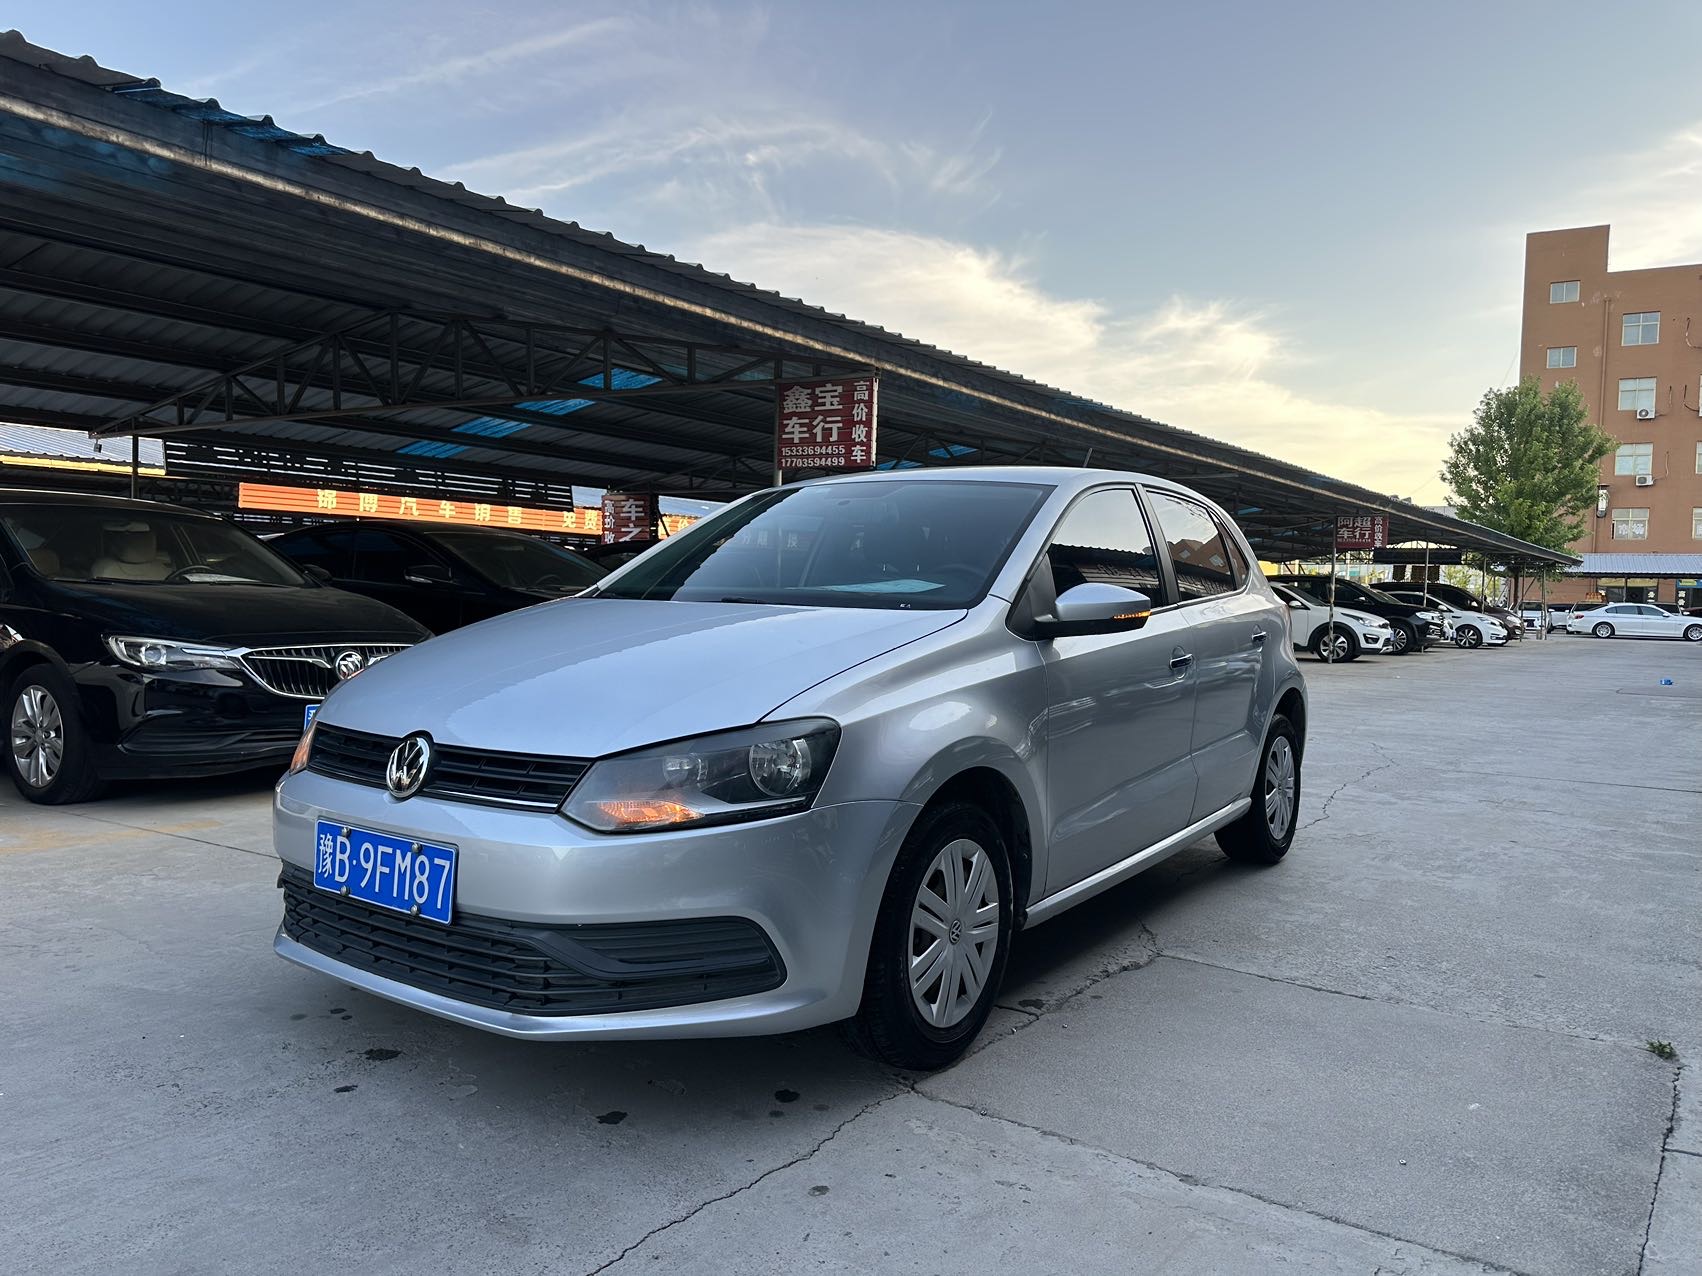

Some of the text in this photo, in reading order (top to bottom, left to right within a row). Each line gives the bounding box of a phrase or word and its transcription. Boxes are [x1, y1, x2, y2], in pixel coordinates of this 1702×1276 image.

[783, 384, 843, 413] 鑫宝
[782, 416, 843, 443] 车行
[851, 381, 870, 463] 高价收车
[781, 445, 845, 456] 15333694455
[781, 457, 845, 467] 17703594499
[1338, 517, 1371, 527] 阿超
[1337, 528, 1371, 539] 车行
[1374, 517, 1382, 548] 高价收车
